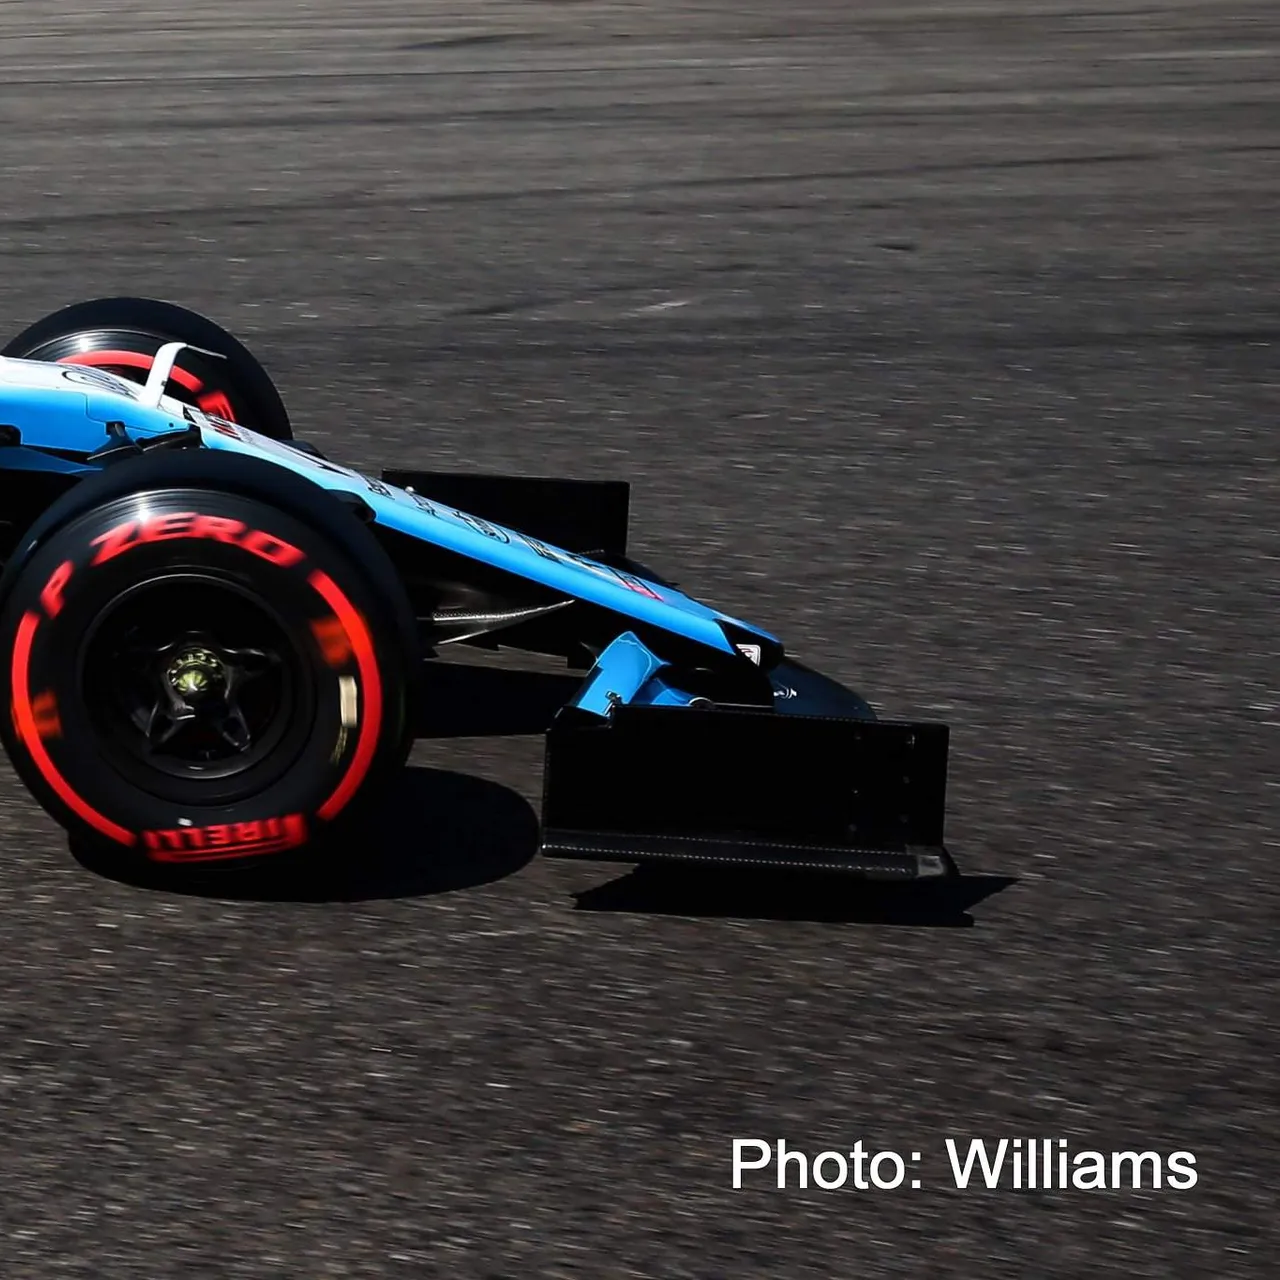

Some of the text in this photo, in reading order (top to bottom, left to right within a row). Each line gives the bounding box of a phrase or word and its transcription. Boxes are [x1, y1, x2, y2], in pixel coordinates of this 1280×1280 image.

[40, 512, 306, 618] P ZERO
[144, 813, 307, 862] PIRELLI
